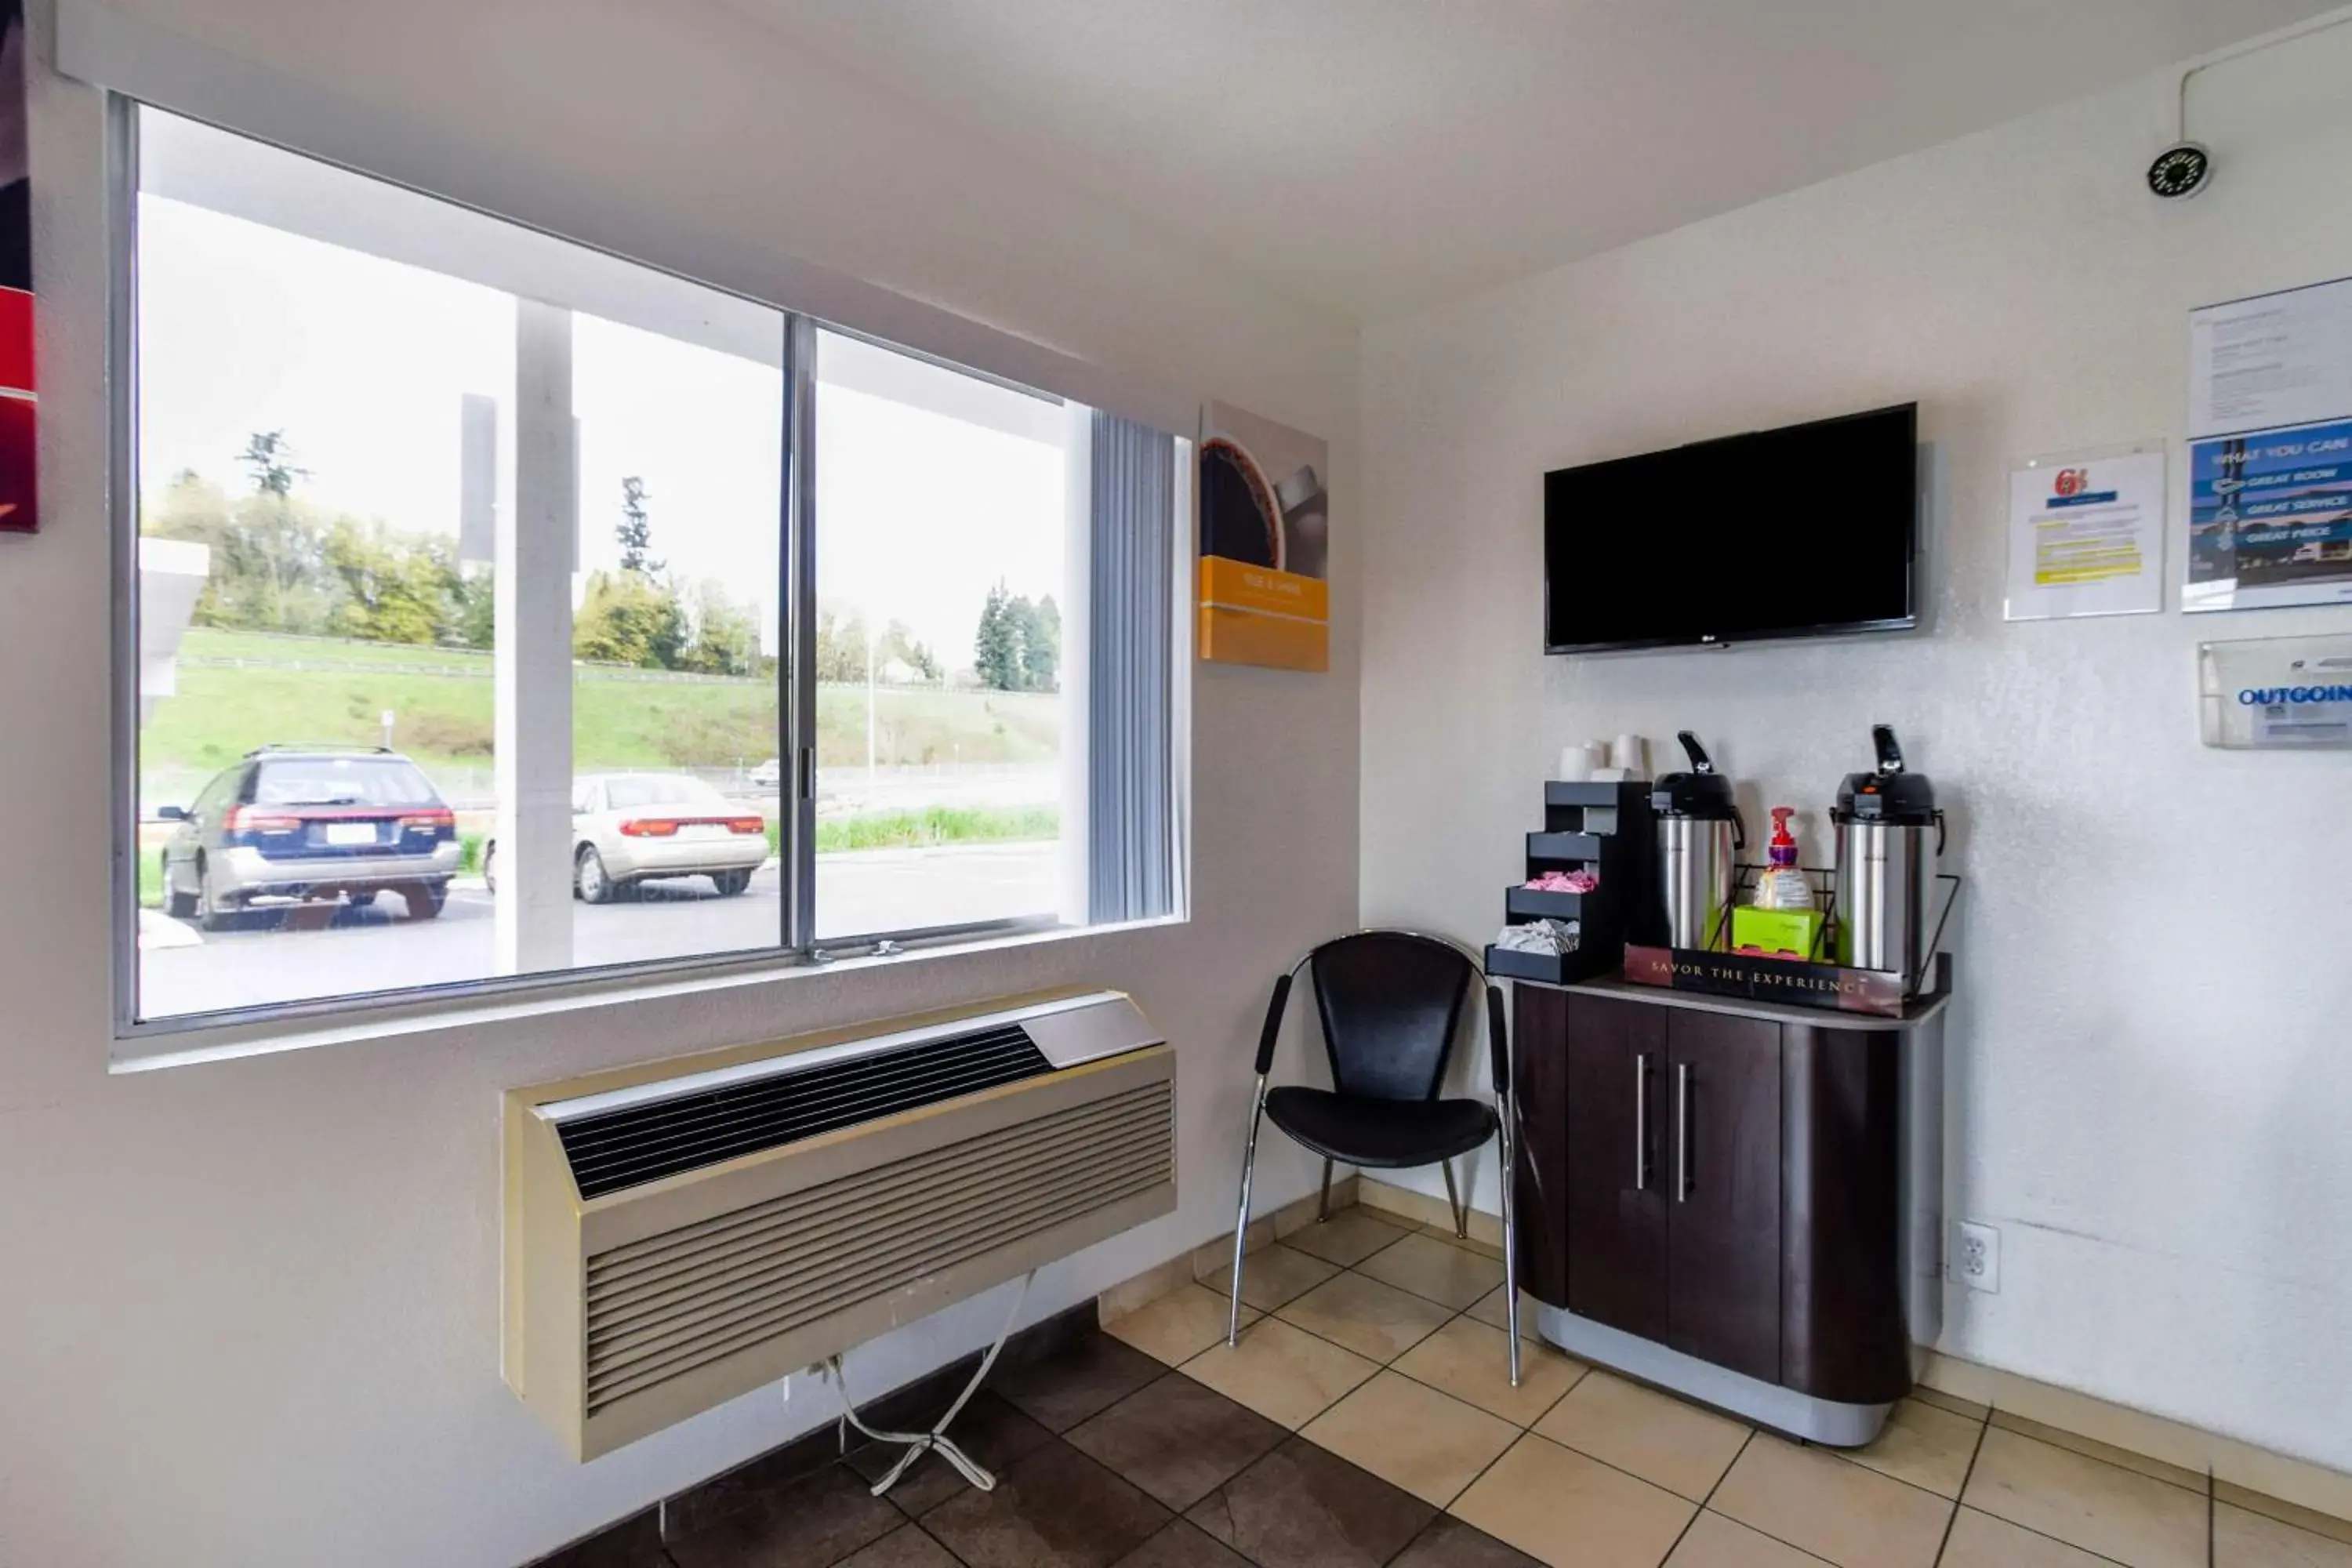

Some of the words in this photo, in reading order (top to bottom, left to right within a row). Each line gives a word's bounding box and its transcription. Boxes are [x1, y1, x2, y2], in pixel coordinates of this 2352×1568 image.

[2212, 448, 2259, 464] WHAT
[2267, 445, 2303, 457] YOU
[2308, 437, 2348, 454] CAN
[2248, 474, 2290, 486] GREAT
[2293, 470, 2338, 481] ROOM
[2248, 502, 2290, 514] GREAT
[2292, 495, 2347, 510] SERVICE
[2246, 531, 2291, 543] GREAT
[2292, 527, 2331, 539] PRICE
[1651, 961, 1704, 978] SAVOR
[1711, 967, 1744, 982] THE
